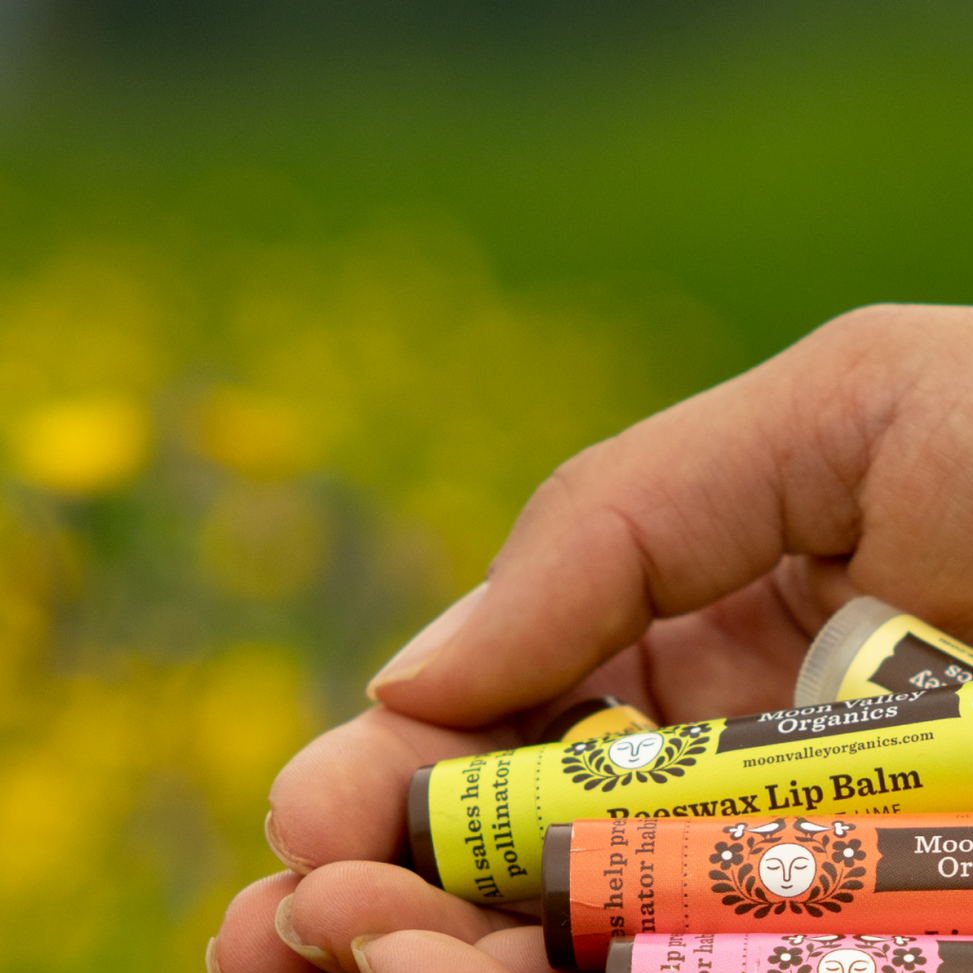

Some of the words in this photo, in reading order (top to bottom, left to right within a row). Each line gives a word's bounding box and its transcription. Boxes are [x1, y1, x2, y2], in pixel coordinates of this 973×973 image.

[757, 704, 833, 722] Moon
[844, 690, 928, 710] Valley
[776, 704, 898, 734] Organics
[743, 732, 935, 768] moonvalleyorganics.com
[461, 758, 487, 801] help
[765, 779, 824, 811] Lip
[829, 767, 924, 801] Balm
[465, 804, 490, 870] sales
[492, 760, 528, 878] pollinator
[475, 875, 504, 898] All
[603, 852, 628, 909] help
